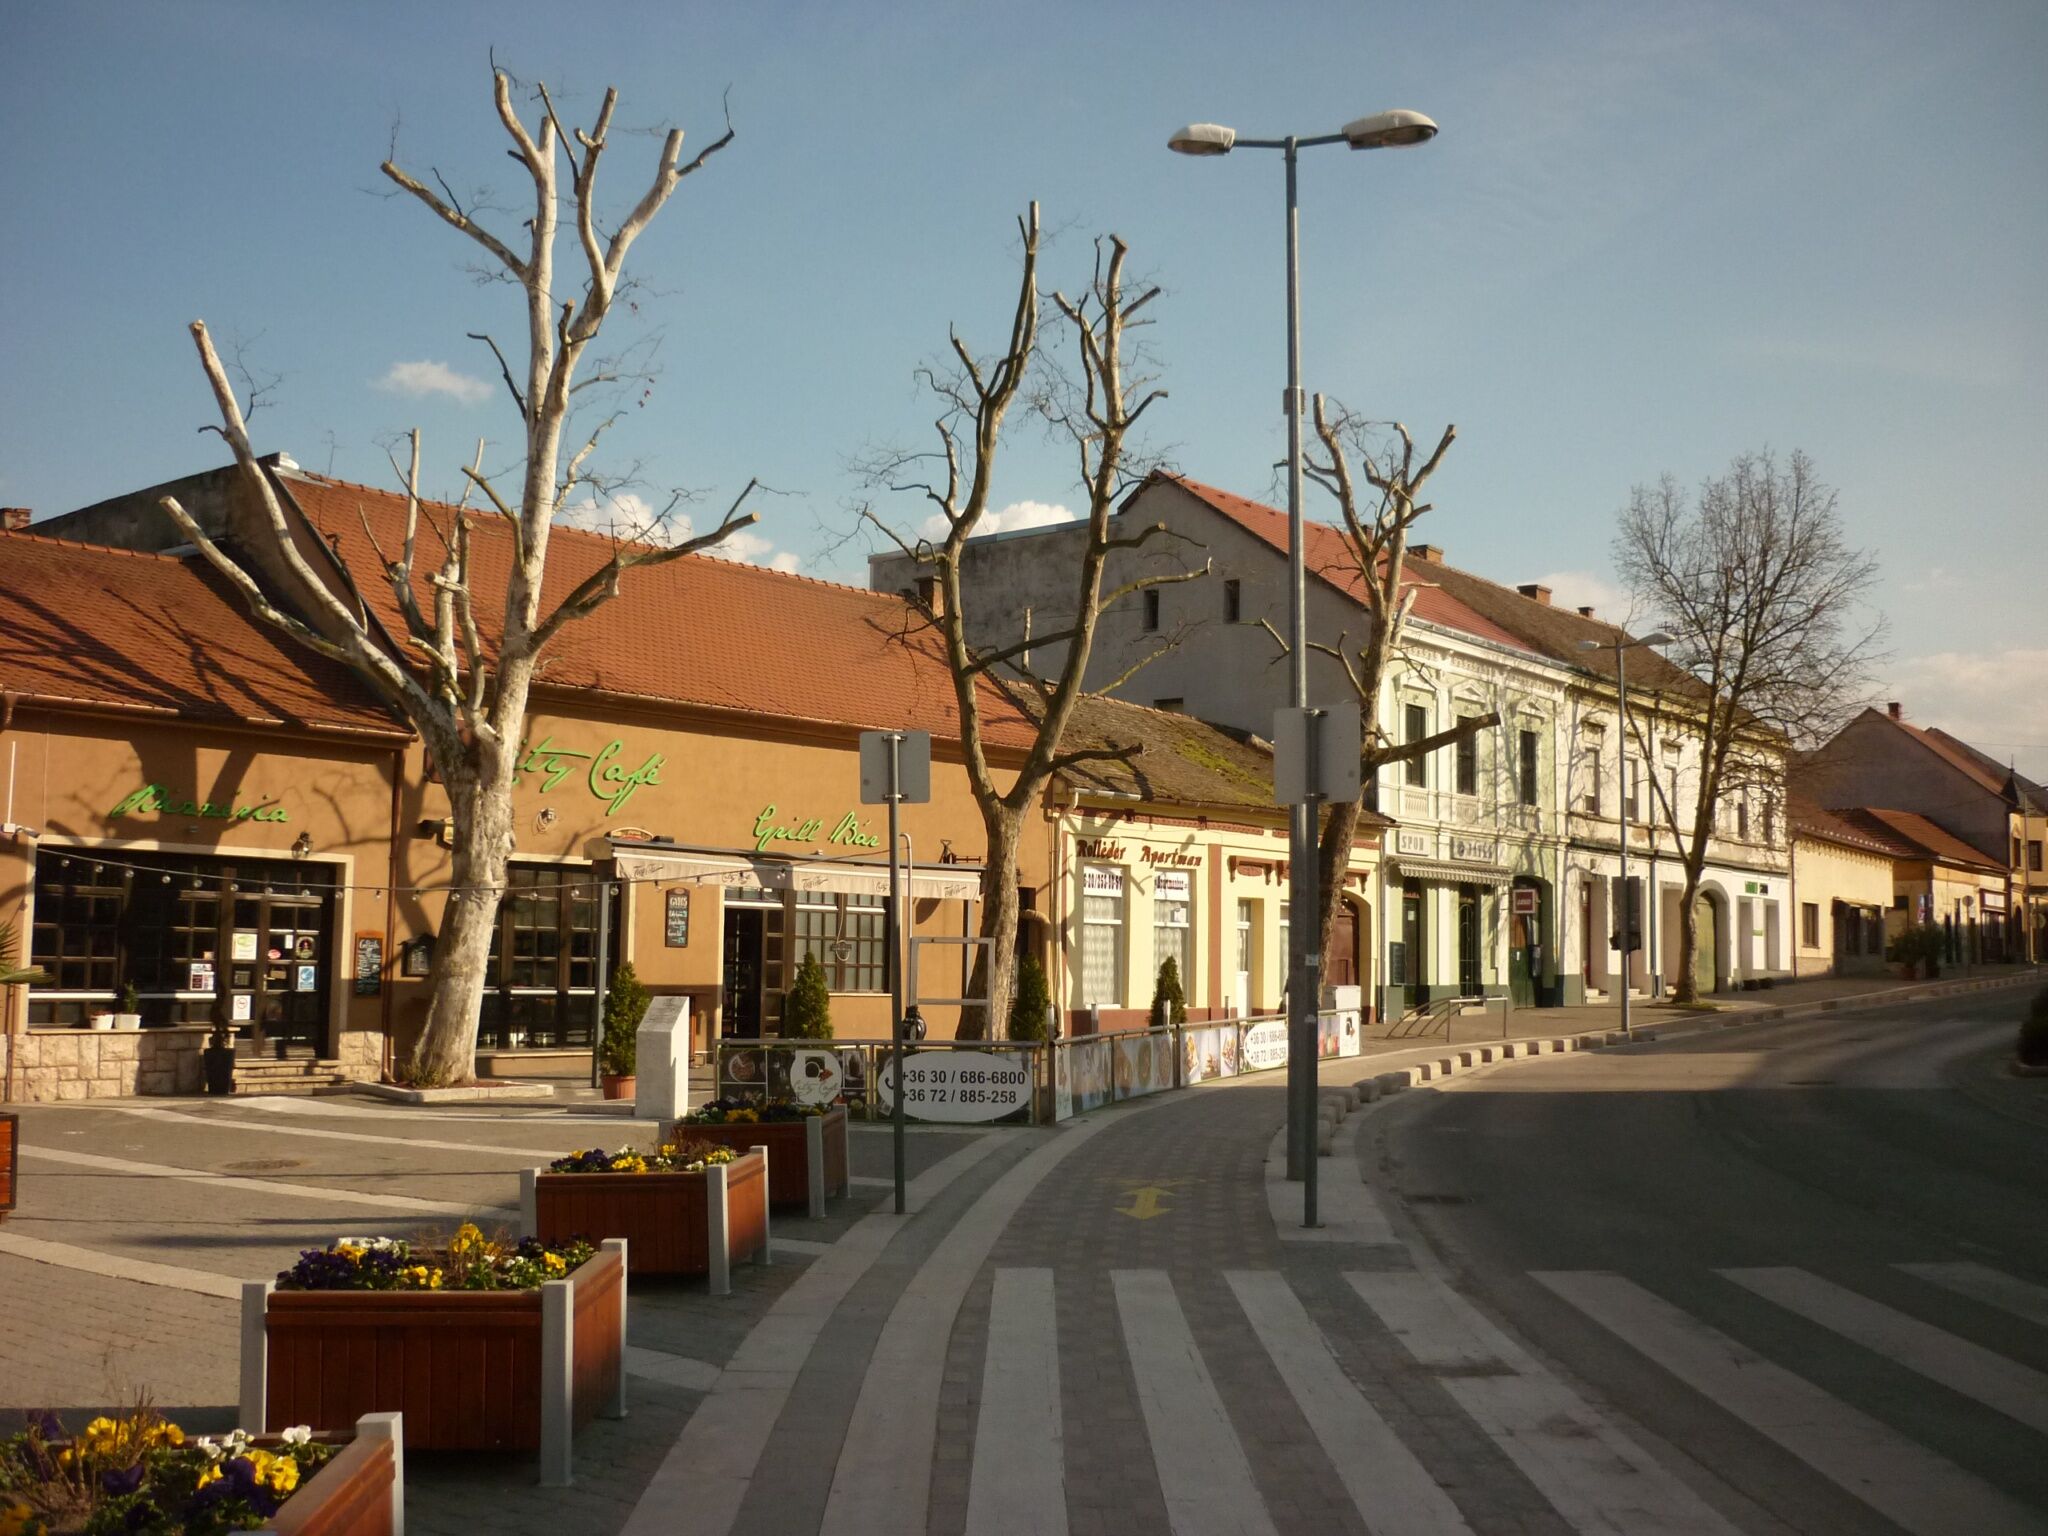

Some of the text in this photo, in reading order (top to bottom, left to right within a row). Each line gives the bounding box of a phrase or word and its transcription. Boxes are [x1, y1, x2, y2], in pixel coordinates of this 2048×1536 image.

[512, 736, 667, 817] ity Café
[753, 804, 880, 852] Grill Bár
[1140, 845, 1202, 869] Apartman
[930, 1070, 947, 1083] 30
[960, 1071, 1025, 1085] 686-6800
[930, 1089, 947, 1103] 72
[960, 1089, 1017, 1104] 885-258
